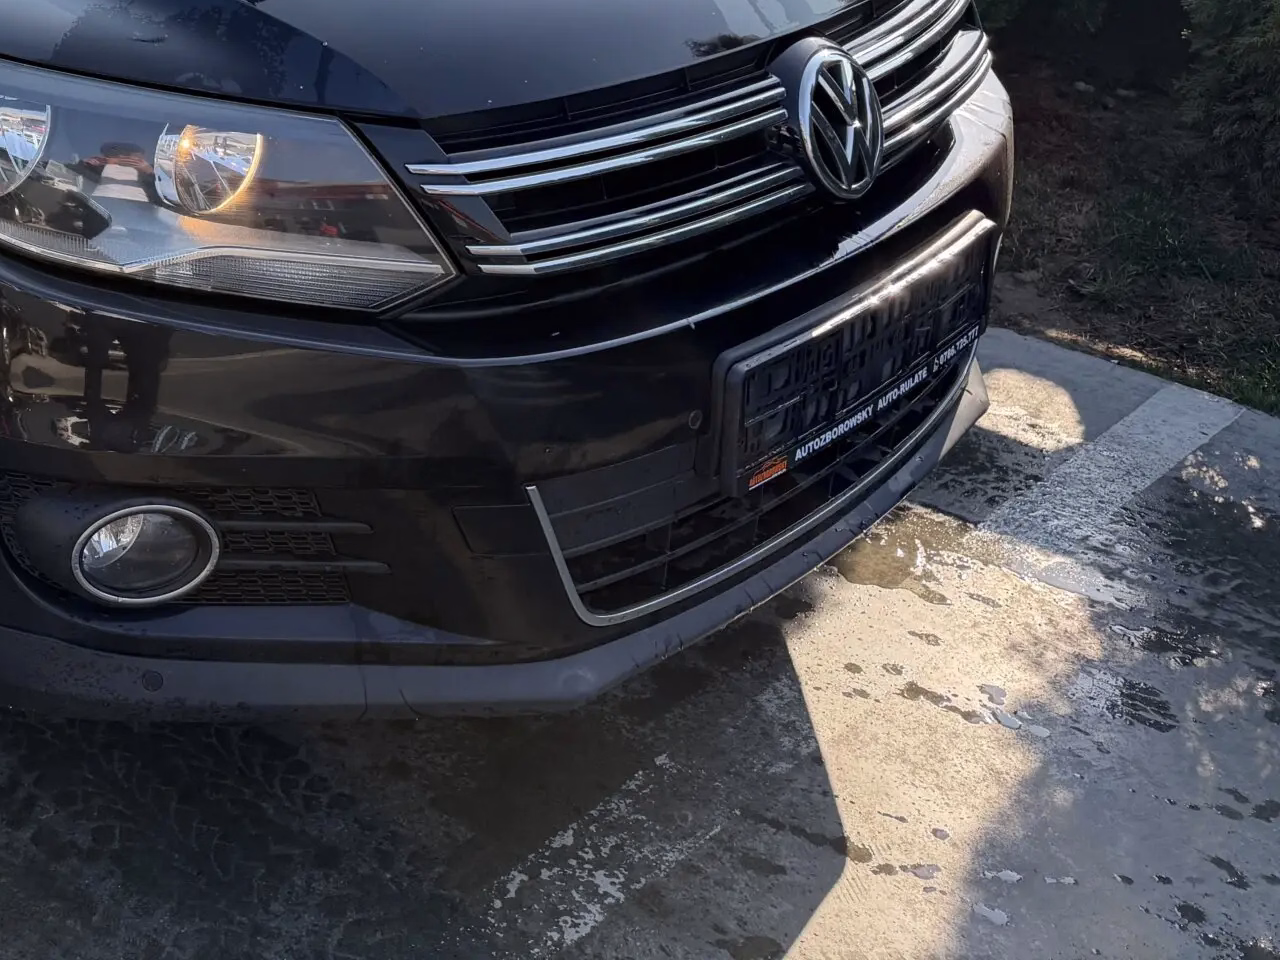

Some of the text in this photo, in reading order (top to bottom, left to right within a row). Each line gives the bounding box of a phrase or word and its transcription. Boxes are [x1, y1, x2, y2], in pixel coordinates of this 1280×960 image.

[799, 49, 884, 198] VW
[795, 404, 874, 461] AUTOZBOROWSKY
[877, 368, 928, 411] AUTO-RULATE
